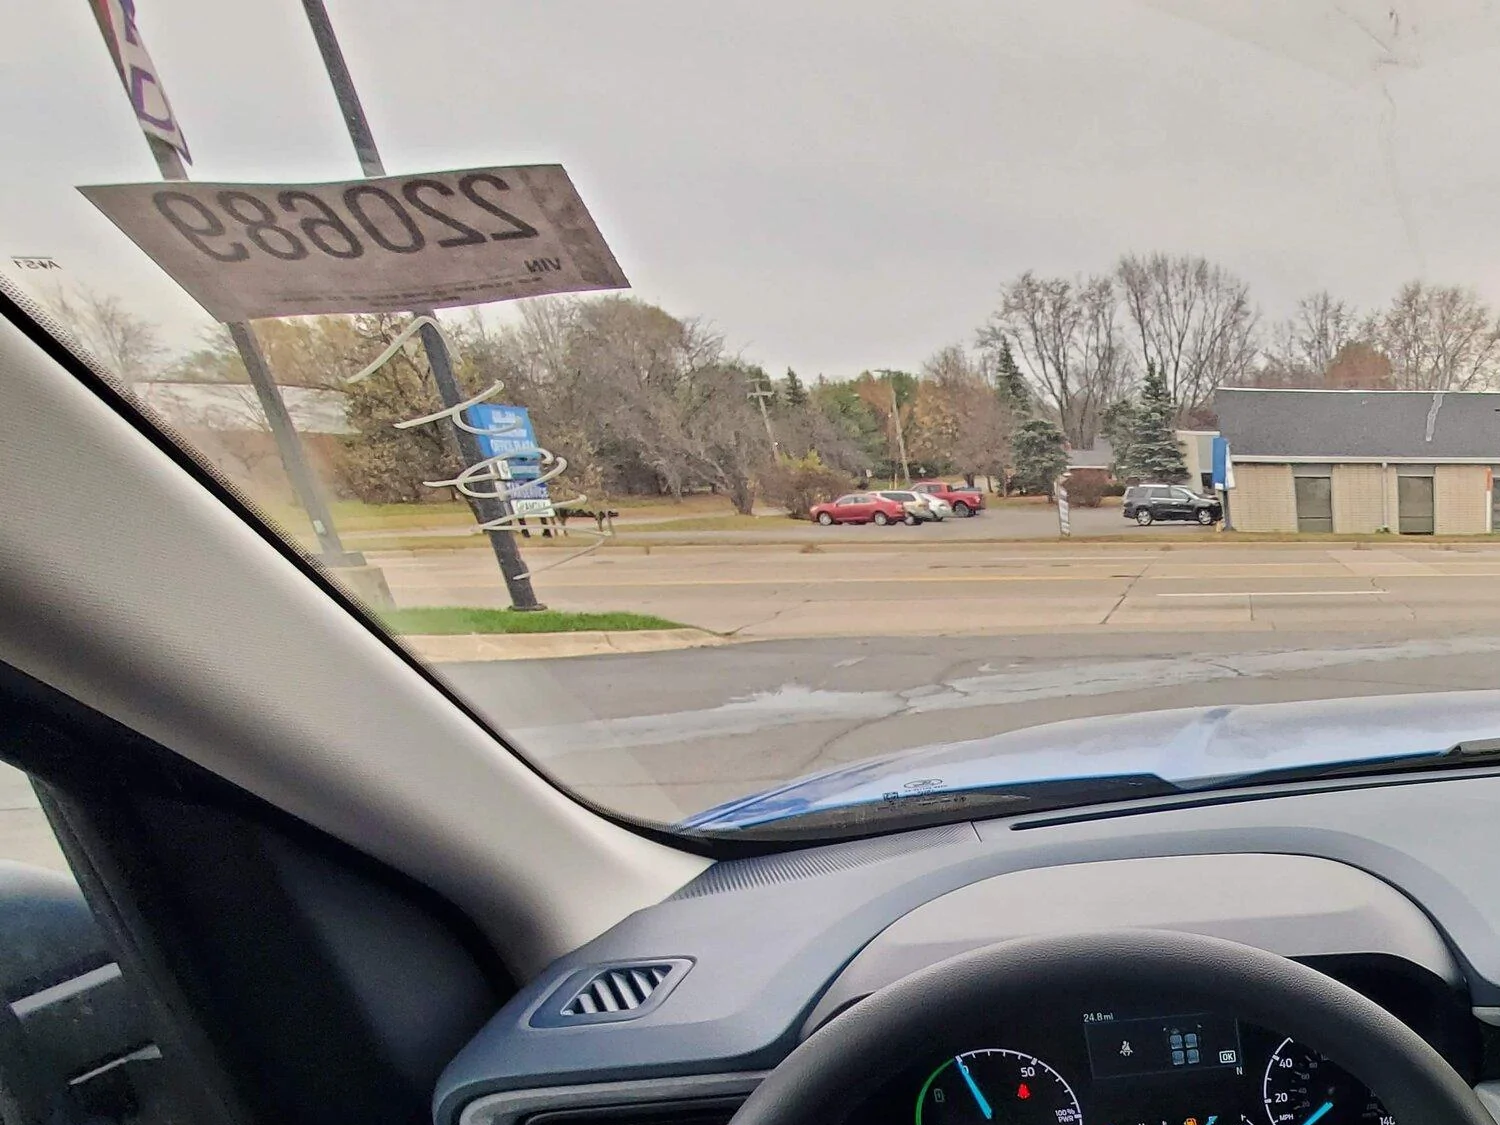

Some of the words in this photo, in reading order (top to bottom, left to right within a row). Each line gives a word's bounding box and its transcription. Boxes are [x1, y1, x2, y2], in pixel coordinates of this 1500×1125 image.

[1279, 1058, 1293, 1068] 40
[1020, 1066, 1036, 1077] 50
[1236, 1067, 1243, 1075] N
[1275, 1092, 1288, 1103] 20
